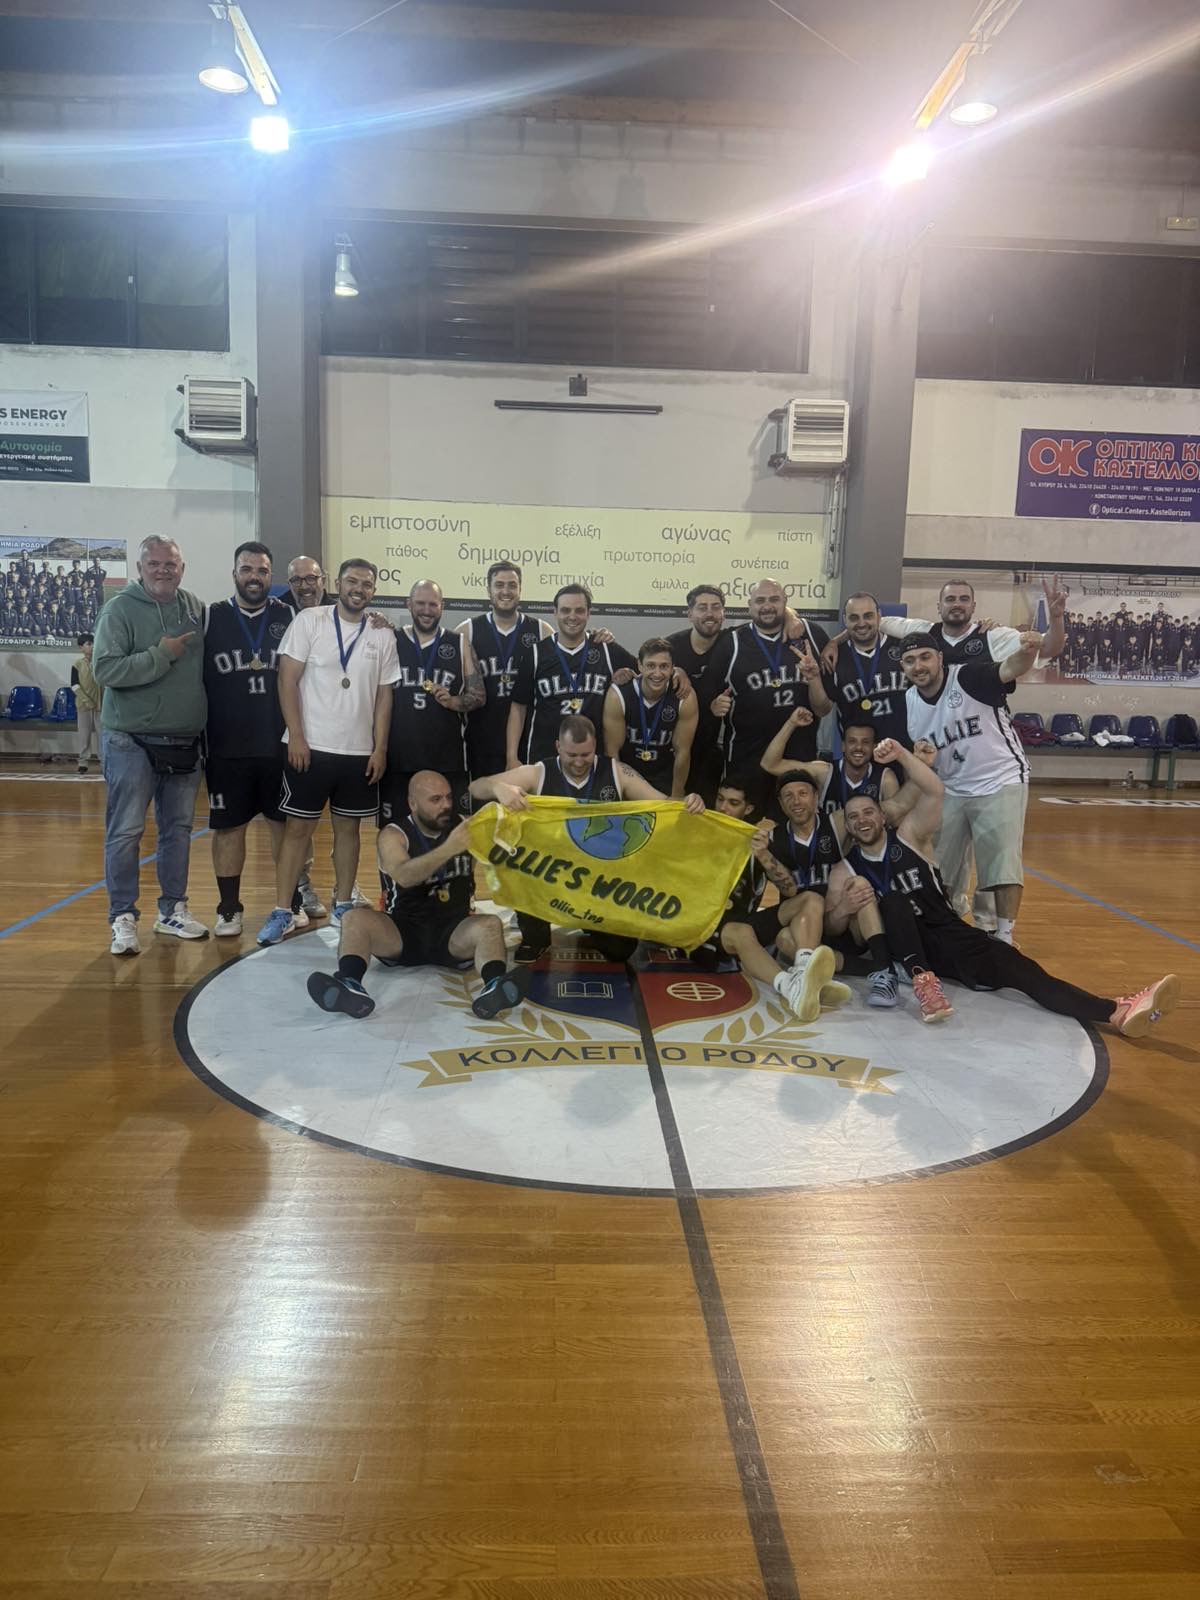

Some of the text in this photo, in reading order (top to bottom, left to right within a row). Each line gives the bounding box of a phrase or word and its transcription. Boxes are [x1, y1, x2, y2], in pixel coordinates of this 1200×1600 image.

[11, 408, 67, 420] ENERGY
[1, 440, 62, 453] Αυτονομία
[1096, 439, 1175, 460] ΟΠΤΙΚΑ
[1093, 458, 1200, 480] ΚΑΣΤΕΛΛΟ
[350, 514, 471, 536] εμπιστοσύνη
[554, 523, 601, 539] εξέλιξη
[661, 523, 732, 544] αγώνας
[777, 528, 813, 544] πίστη
[385, 545, 428, 560] πάθος
[458, 543, 561, 566] δημιουργία
[603, 548, 696, 567] πρωτοπορία
[731, 556, 789, 571] συνέπεια
[540, 571, 605, 591] επιτυχία
[651, 578, 690, 591] άμιλλα
[248, 675, 267, 694] 11
[413, 692, 427, 710] 5
[773, 689, 794, 708] 12
[872, 697, 893, 717] 21
[919, 714, 983, 751] LLIE
[488, 844, 591, 890] OLLIE'S
[591, 874, 682, 920] WORLD
[458, 1046, 846, 1072] ΚΟΛΛΕΓΙΟ ΡΟΔΟΥ
